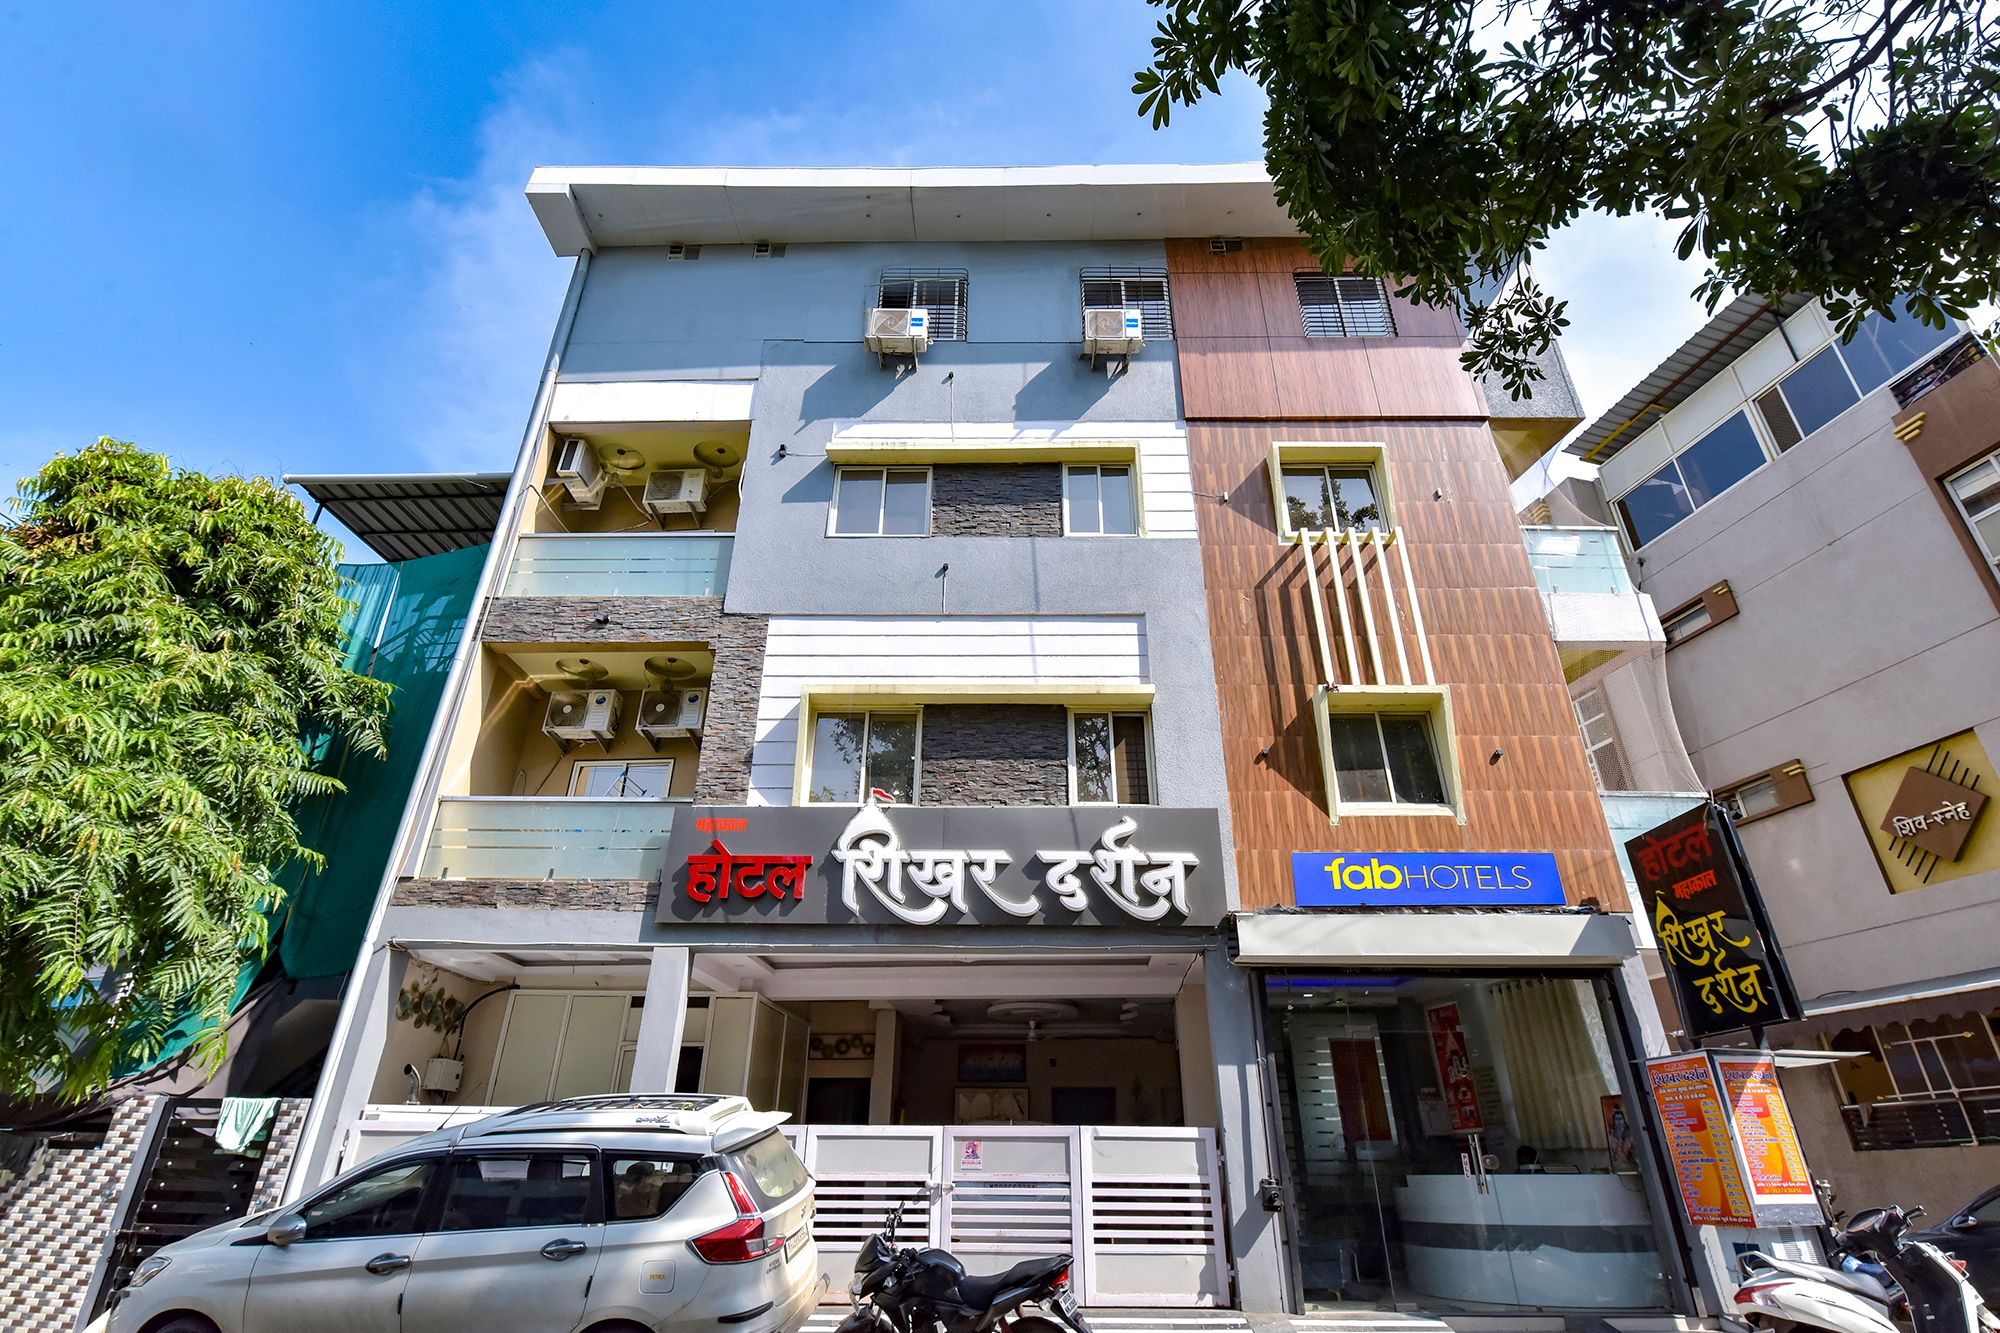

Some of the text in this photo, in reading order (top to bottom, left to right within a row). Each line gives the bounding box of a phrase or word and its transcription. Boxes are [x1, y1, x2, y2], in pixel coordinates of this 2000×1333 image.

[695, 817, 749, 834] महाकाल
[1892, 801, 1972, 837] शिव-स्नेह
[686, 800, 1201, 925] होटल शिखर दर्शन
[1324, 857, 1532, 890] fabHOTELS
[1637, 822, 1713, 881] होटल
[1671, 869, 1718, 899] महाकाल
[1655, 890, 1751, 967] शिखर
[1693, 947, 1769, 1014] दर्शन
